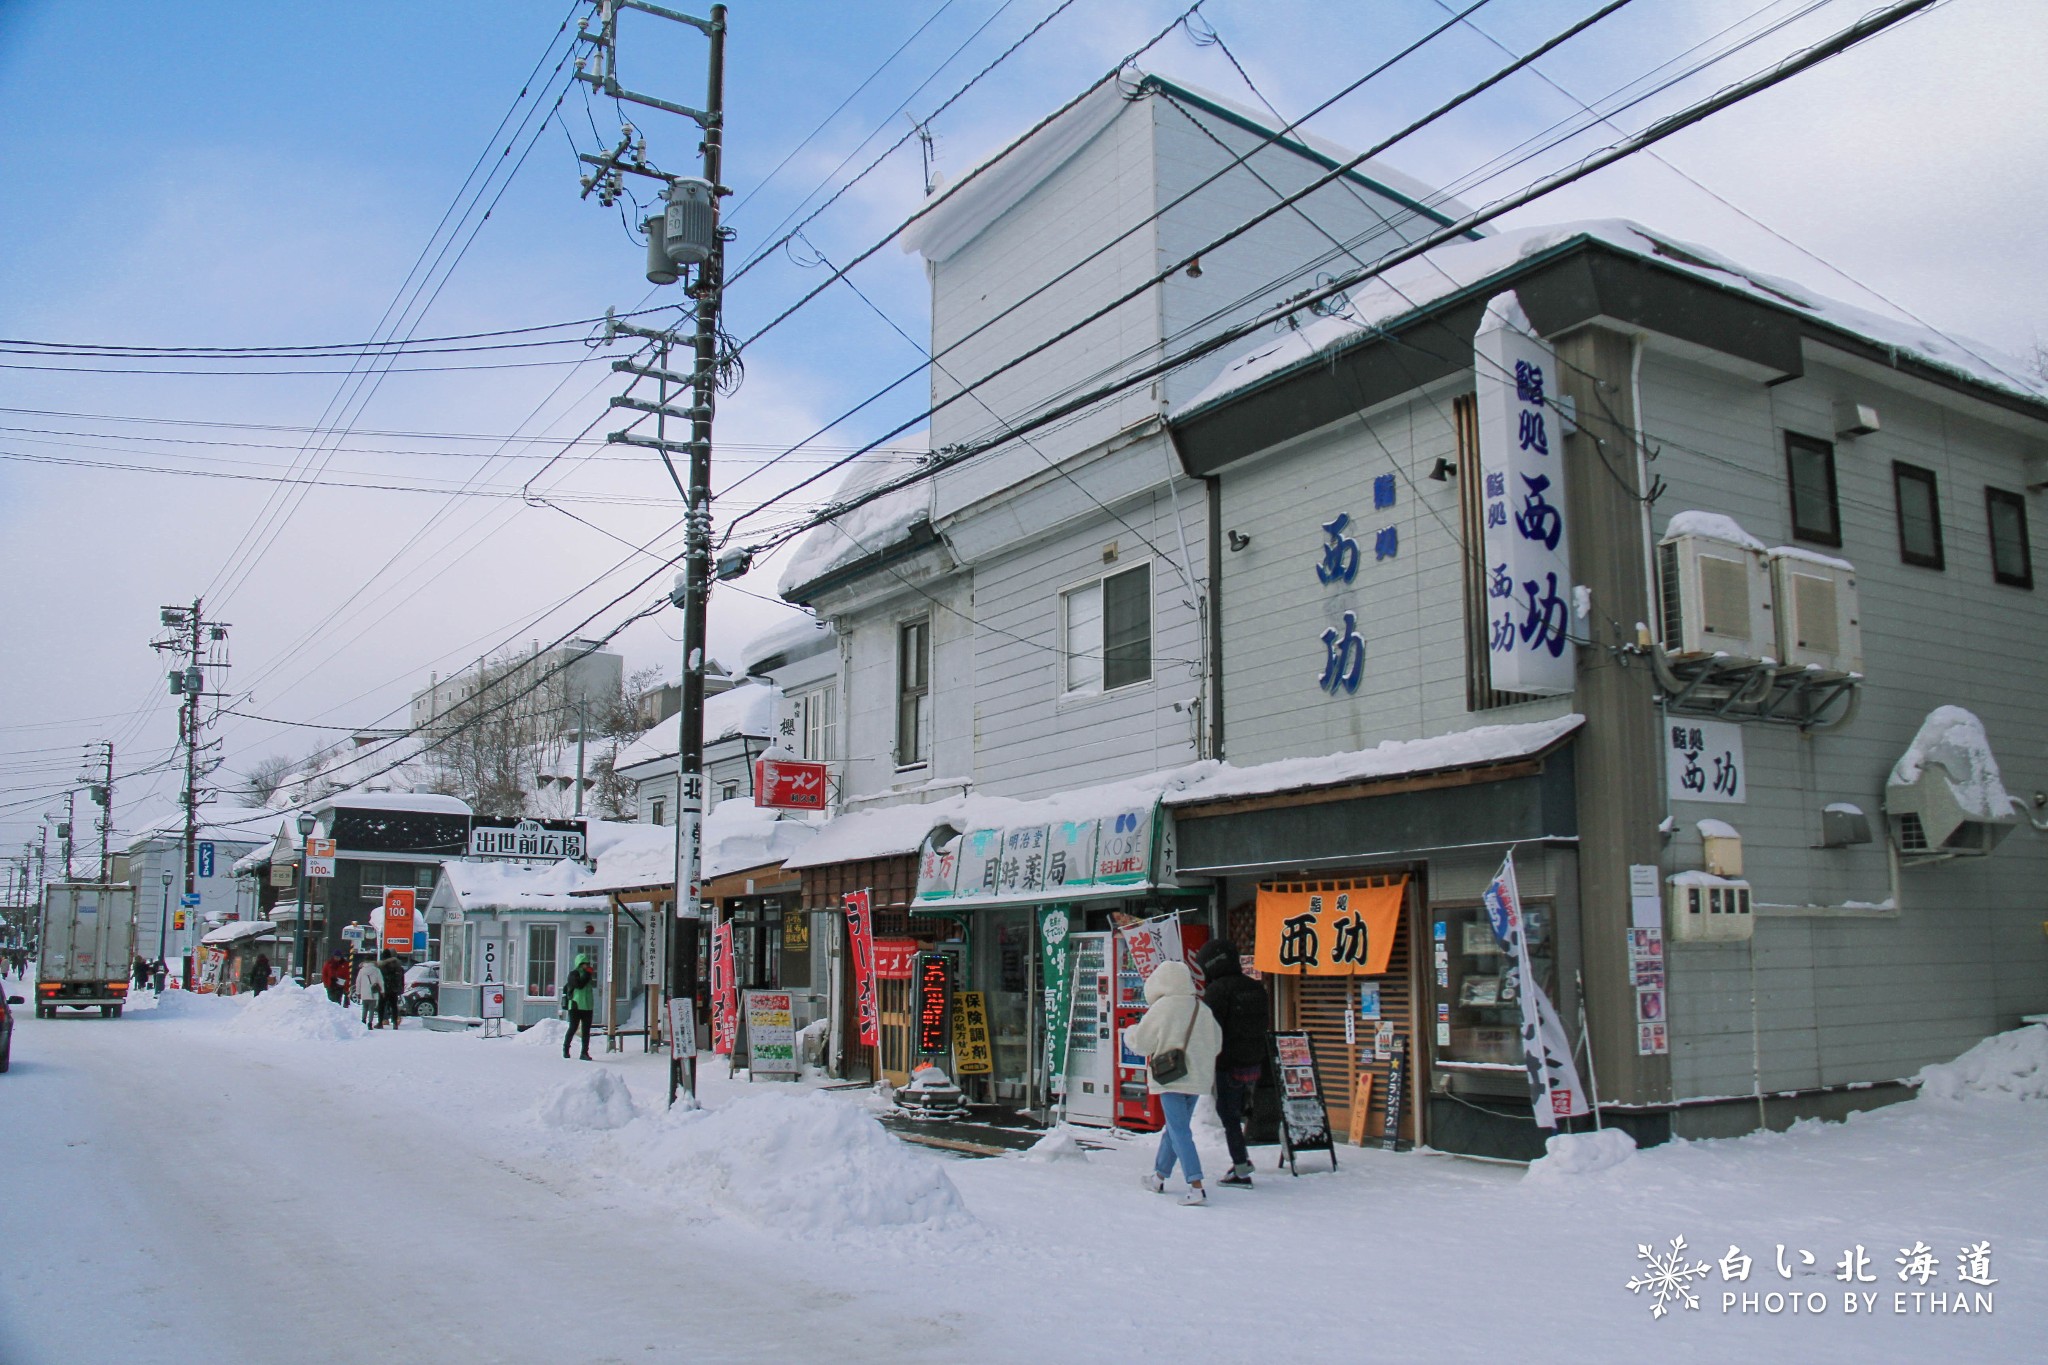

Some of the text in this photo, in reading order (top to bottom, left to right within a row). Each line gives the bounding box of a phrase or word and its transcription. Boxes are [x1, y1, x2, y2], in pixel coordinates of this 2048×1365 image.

[314, 840, 330, 856] P
[476, 831, 580, 857] 出世前広場
[1008, 829, 1043, 850] 明治堂
[1163, 831, 1174, 878] くすり
[922, 851, 955, 879] 漢方
[982, 849, 1068, 890] 目時薬局
[1279, 909, 1369, 968] 西功
[485, 942, 495, 982] POLA
[964, 993, 988, 1060] 保険調剤
